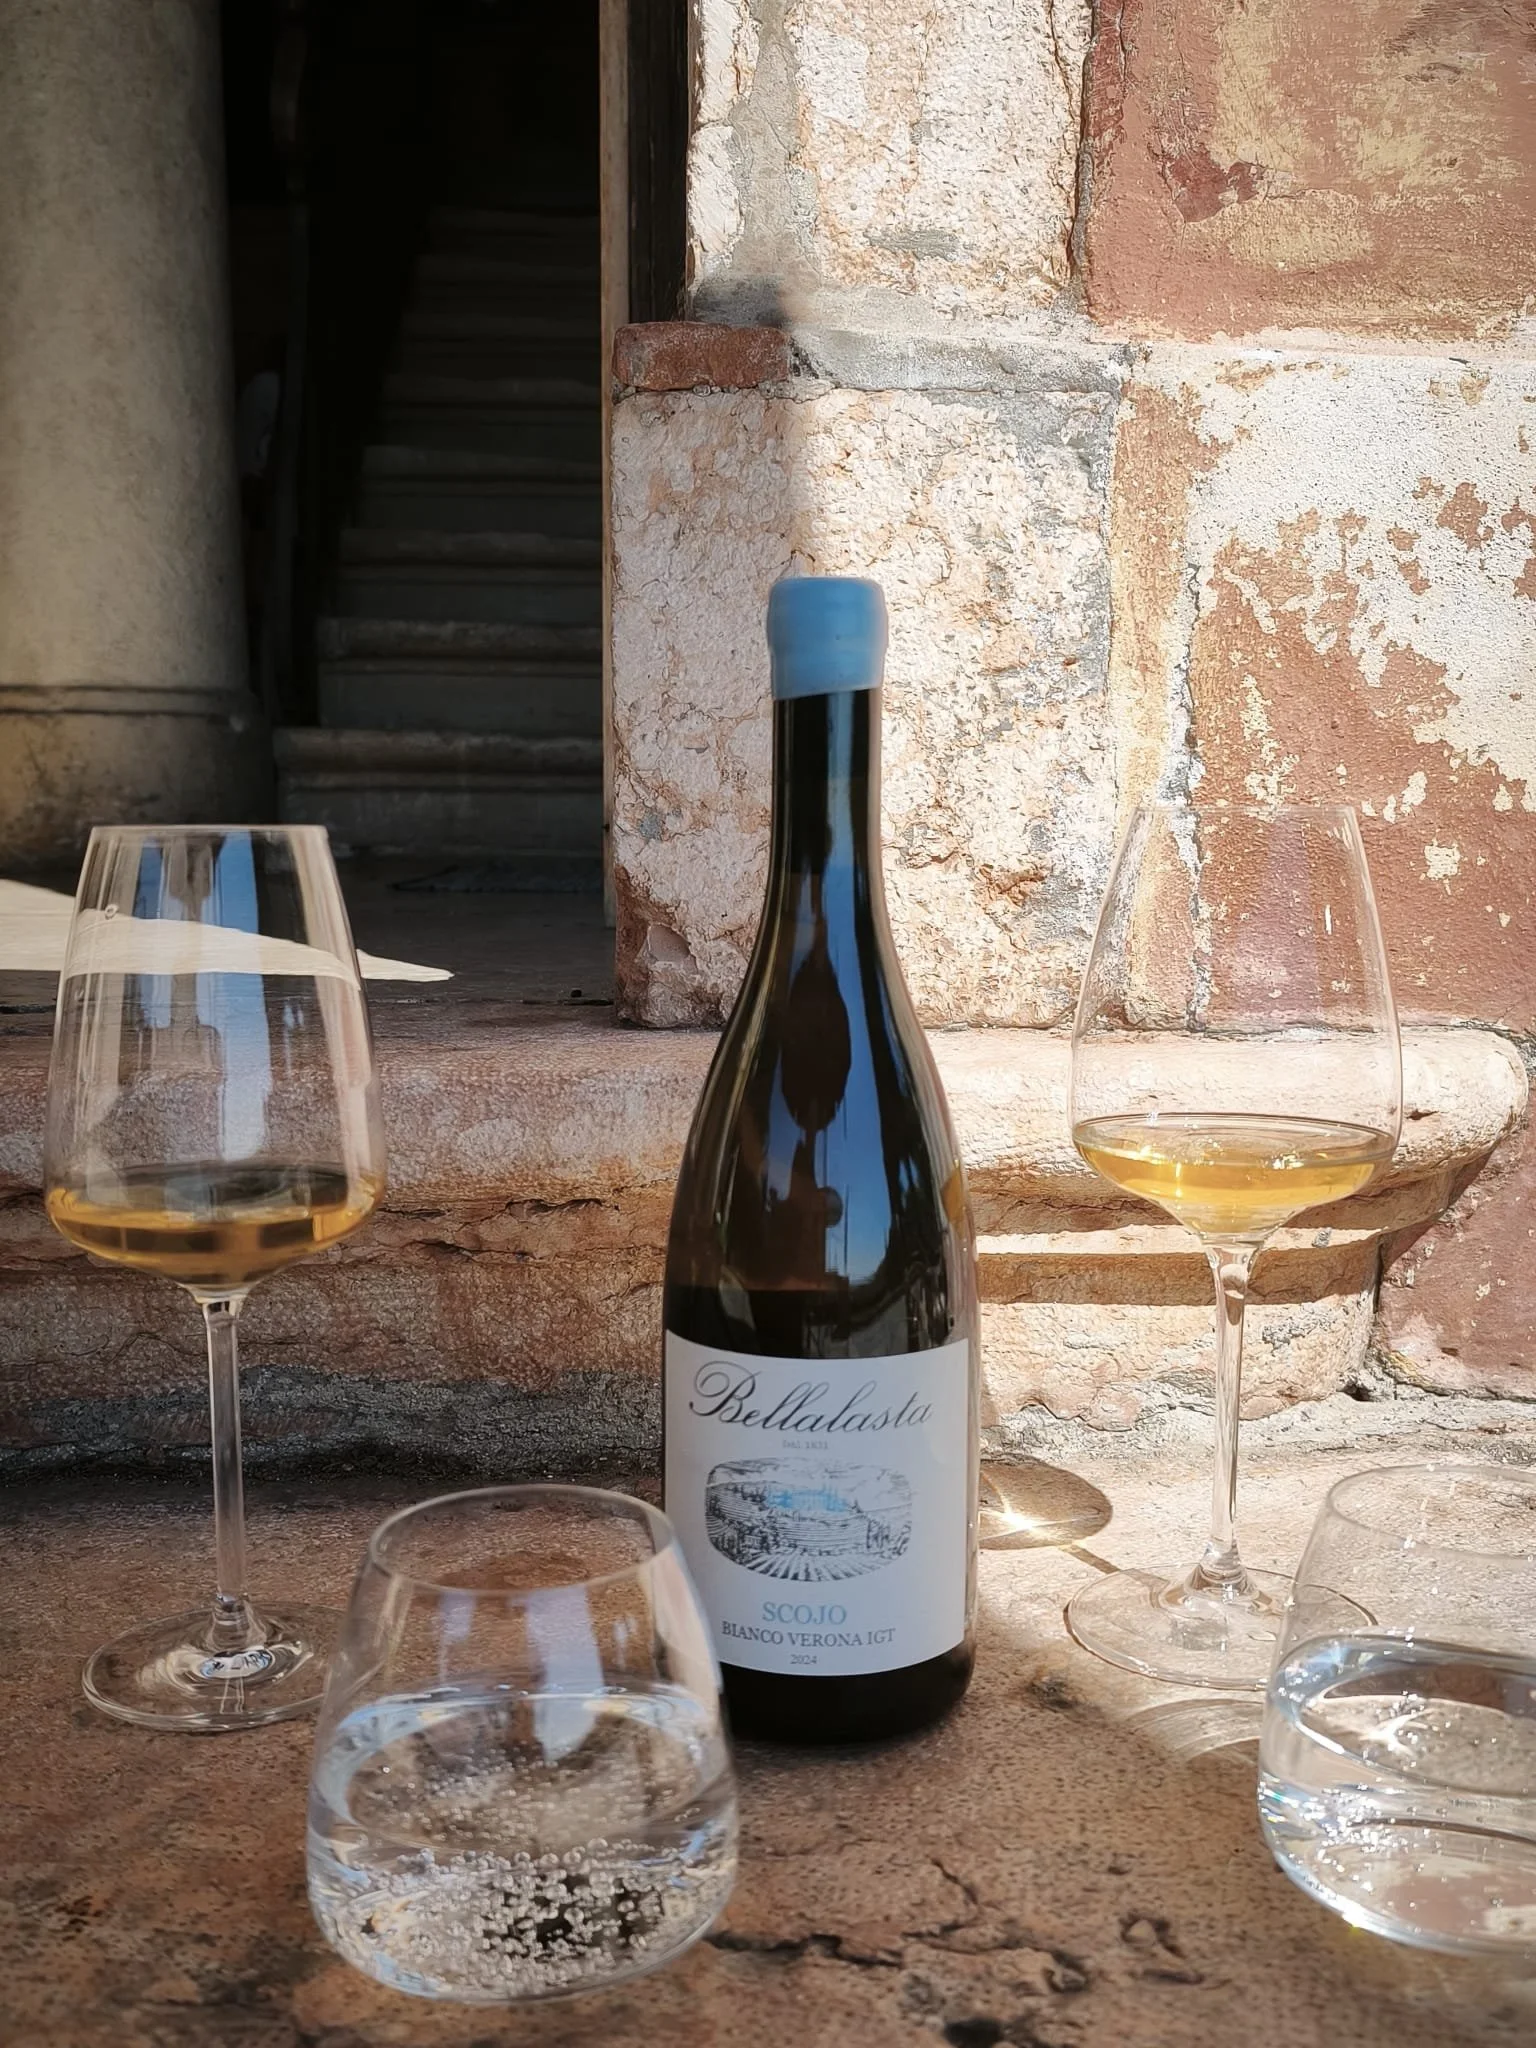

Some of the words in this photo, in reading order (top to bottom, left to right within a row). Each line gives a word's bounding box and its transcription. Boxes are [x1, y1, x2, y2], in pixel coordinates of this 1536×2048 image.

[689, 1360, 933, 1433] Bellalasta
[762, 1601, 847, 1625] SCOJO
[722, 1620, 784, 1645] BIANCO
[788, 1632, 863, 1647] VERONA
[867, 1628, 896, 1645] IGT
[790, 1654, 818, 1665] 2024
